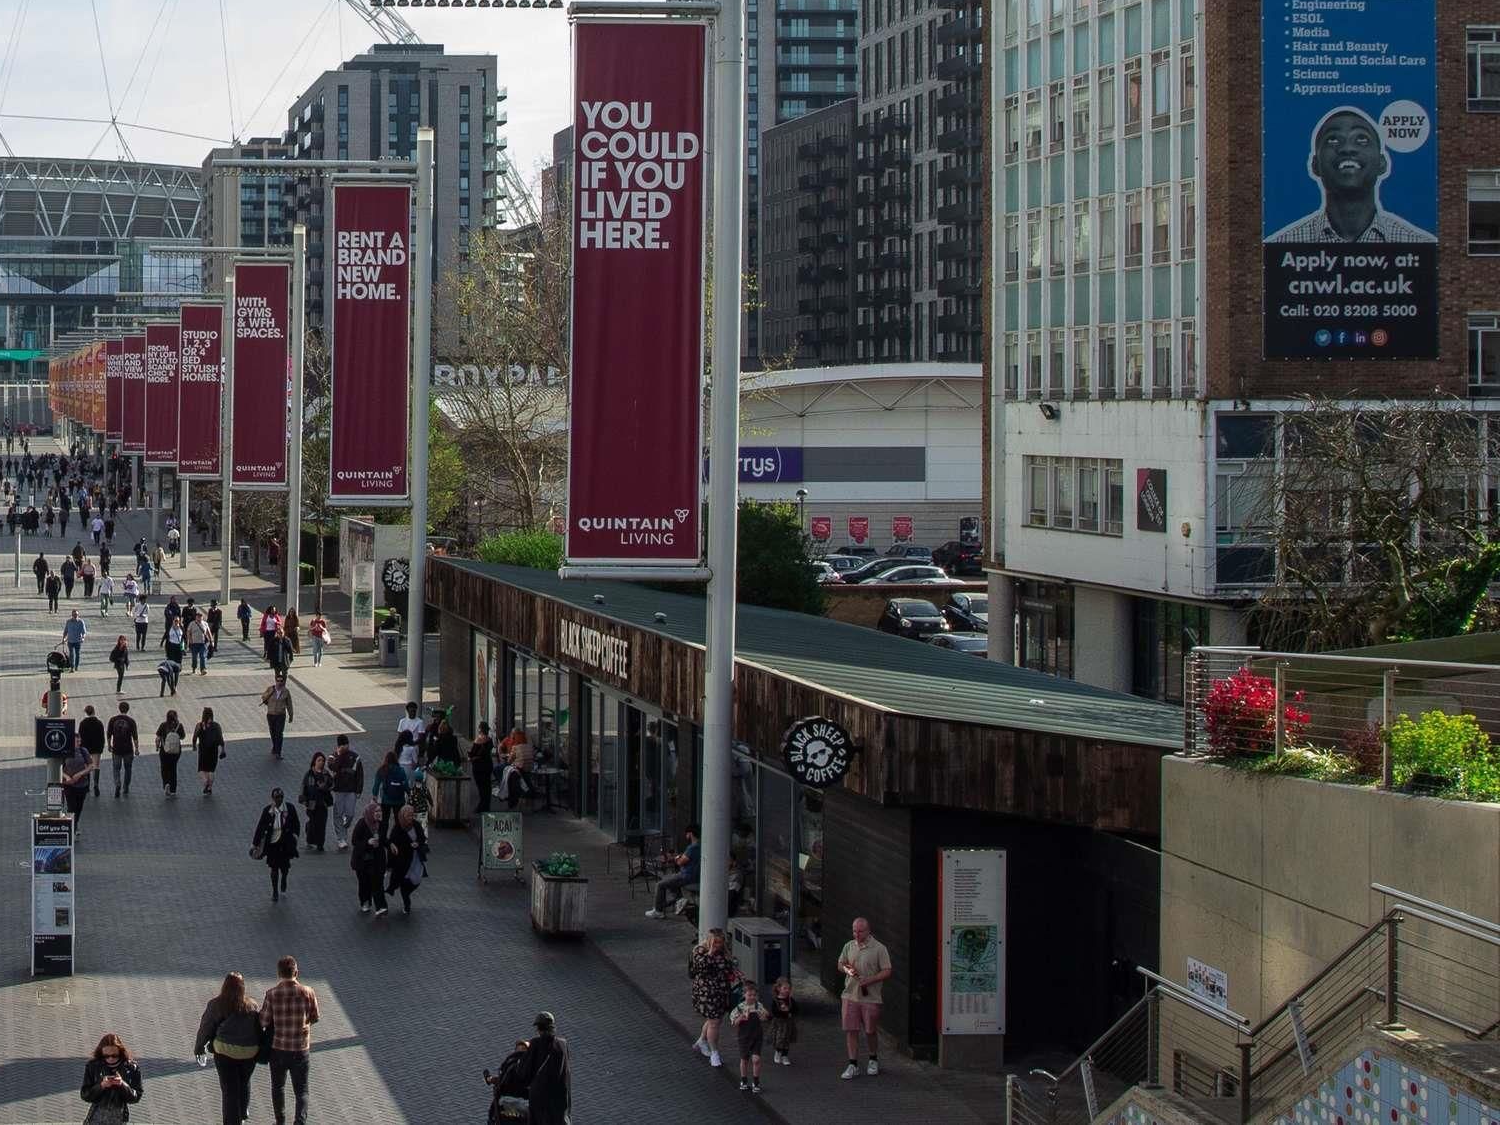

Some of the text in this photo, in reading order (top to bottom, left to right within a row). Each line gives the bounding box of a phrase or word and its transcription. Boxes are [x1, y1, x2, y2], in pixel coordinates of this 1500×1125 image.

[1292, 0, 1365, 11] Engineering
[1292, 13, 1324, 24] ESOL
[1292, 27, 1330, 37] Media
[1292, 41, 1389, 53] Hair and Beauty
[1292, 55, 1426, 65] Health and Social Care
[1292, 69, 1339, 79] Science
[1292, 83, 1392, 95] Apprenticeships
[580, 101, 652, 130] YOU
[1382, 115, 1426, 126] APPLY
[1387, 128, 1421, 139] NOW
[580, 131, 700, 160] COULD
[580, 161, 685, 190] IF YOU
[580, 191, 672, 219] LIVED
[337, 231, 404, 248] RENT A
[580, 221, 670, 249] HERE.
[337, 249, 406, 265] BRAND
[1281, 250, 1420, 272] Apply now, at:
[337, 266, 381, 282] NEW
[1288, 273, 1413, 295] cnwl.ac.uk
[337, 283, 401, 300] HOME.
[237, 297, 267, 307] WITH
[237, 307, 272, 318] GYMS
[1280, 304, 1417, 317] Call: 020 8208 5000
[237, 318, 275, 328] & WFH
[182, 330, 218, 340] STUDIO
[236, 328, 284, 338] SPACES.
[193, 339, 202, 348] 2,
[204, 339, 211, 348] 3
[182, 347, 206, 356] OR 4
[182, 356, 201, 364] BED
[182, 364, 219, 373] STYLISH
[182, 373, 220, 382] HOMES.
[235, 464, 277, 473] QUINTAIN
[336, 471, 393, 481] QUINTAIN
[361, 480, 393, 488] LIVING
[578, 517, 674, 532] QUINTAIN
[620, 532, 674, 545] LIVING
[560, 618, 628, 680] BLACK SHEEP COFFEE
[790, 723, 845, 762] BLACK SHEEP
[805, 756, 847, 783] COFFEE
